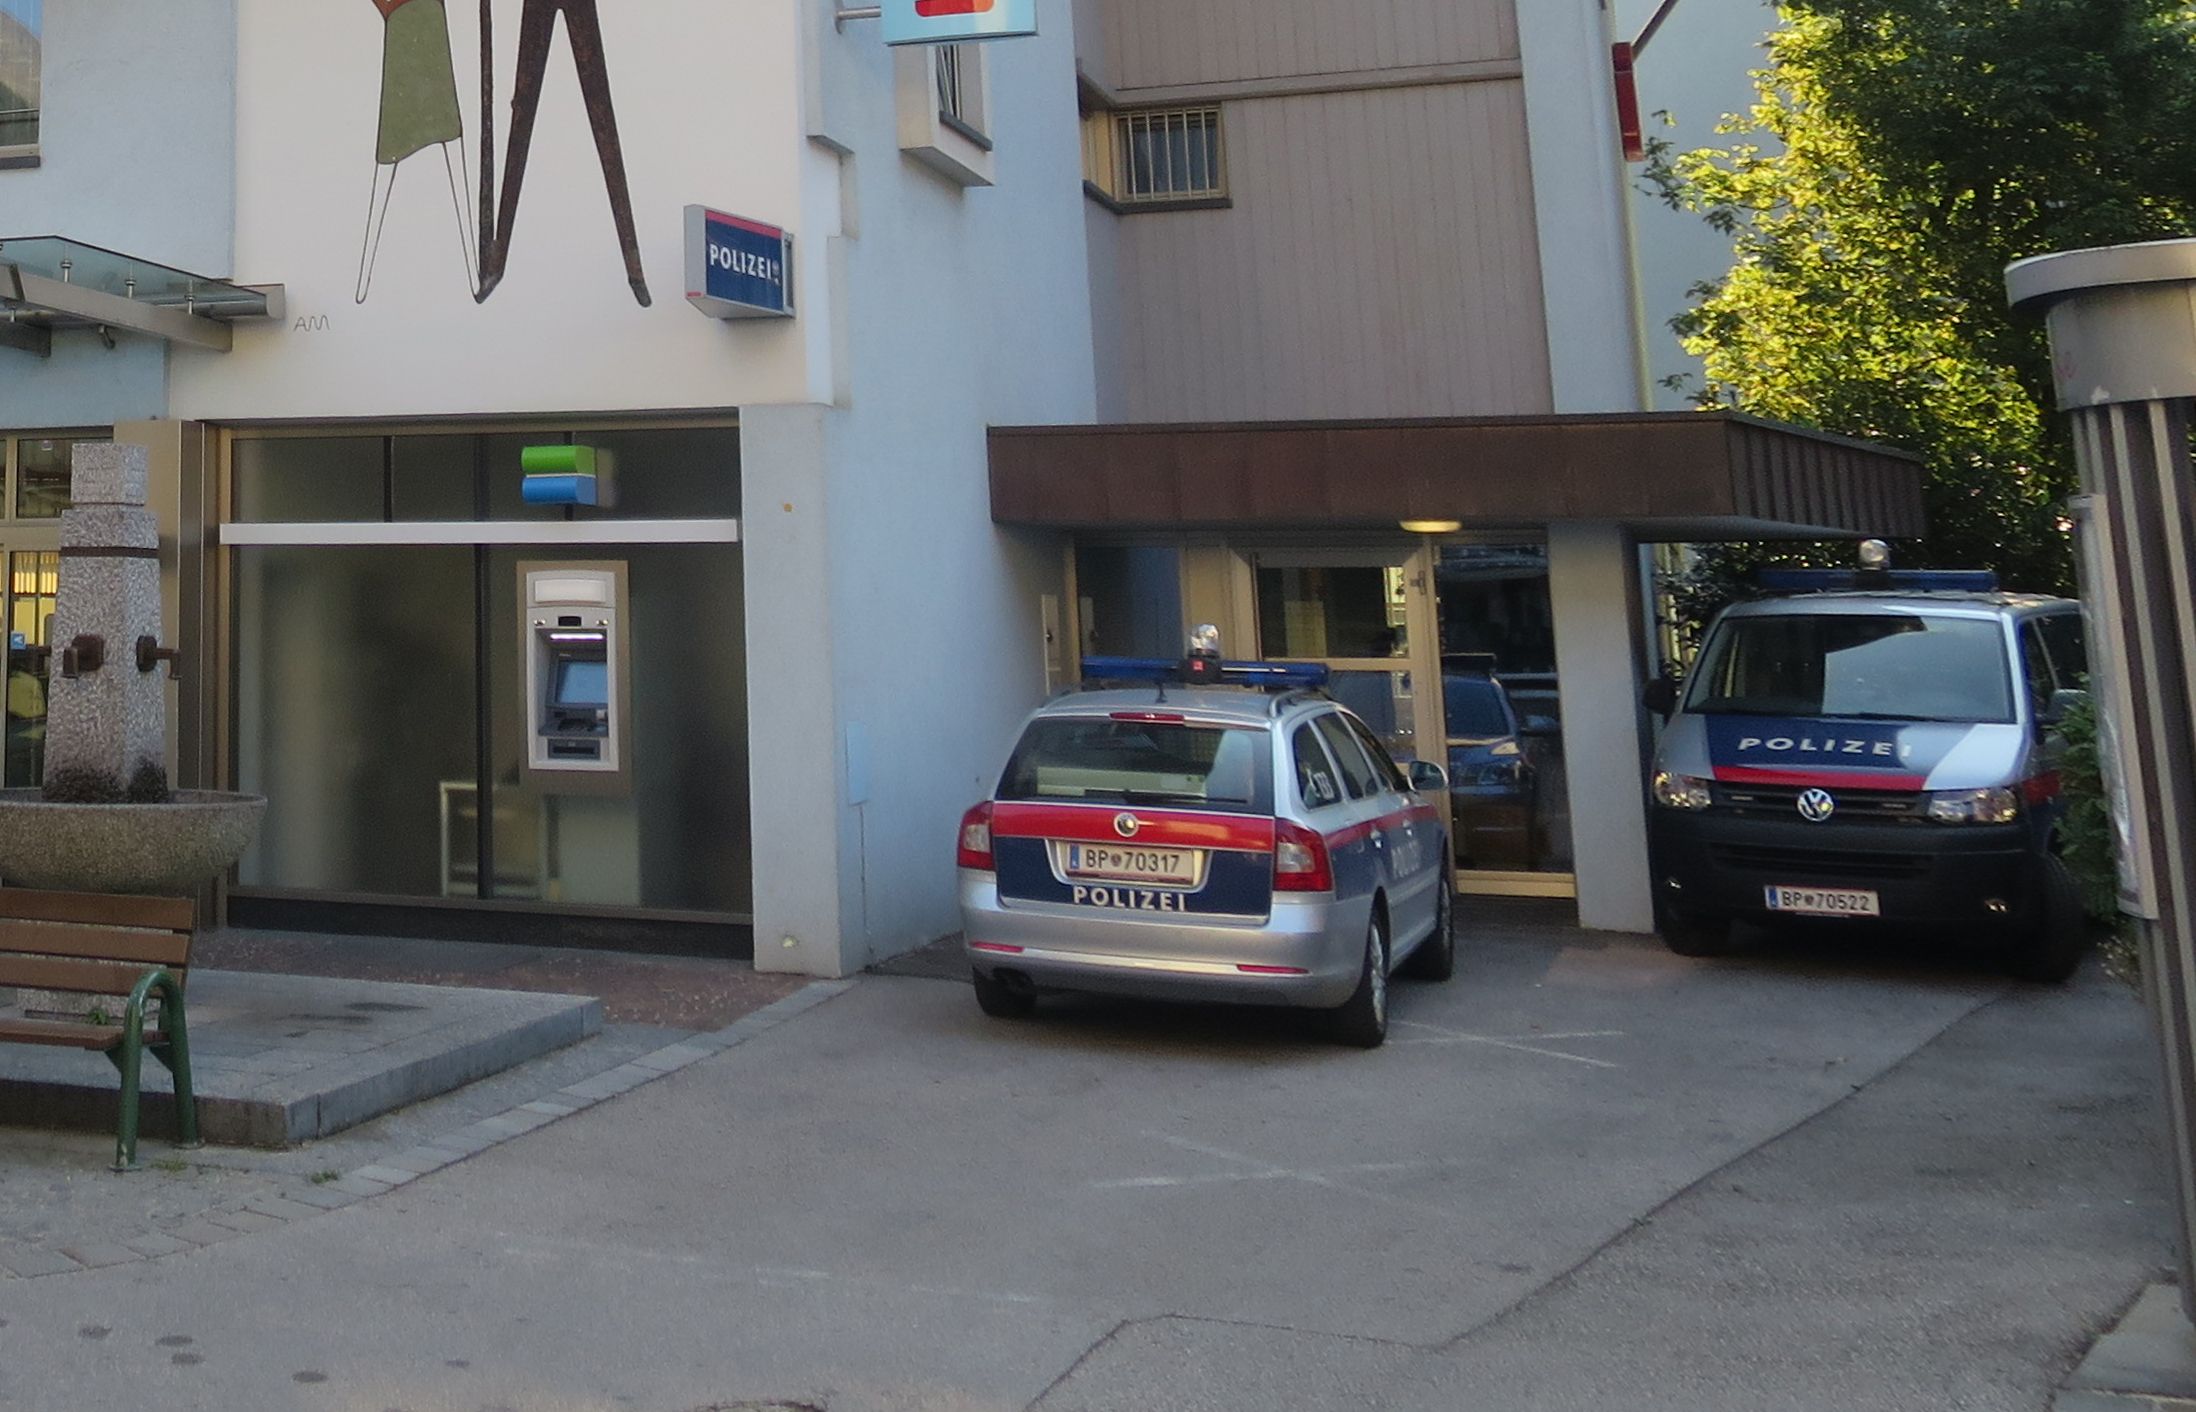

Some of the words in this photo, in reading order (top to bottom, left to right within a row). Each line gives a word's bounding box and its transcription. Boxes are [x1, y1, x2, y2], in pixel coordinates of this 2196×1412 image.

[709, 243, 772, 280] POLIZEI
[1737, 737, 1912, 757] POLIZEI
[1073, 885, 1186, 912] POLIZEI
